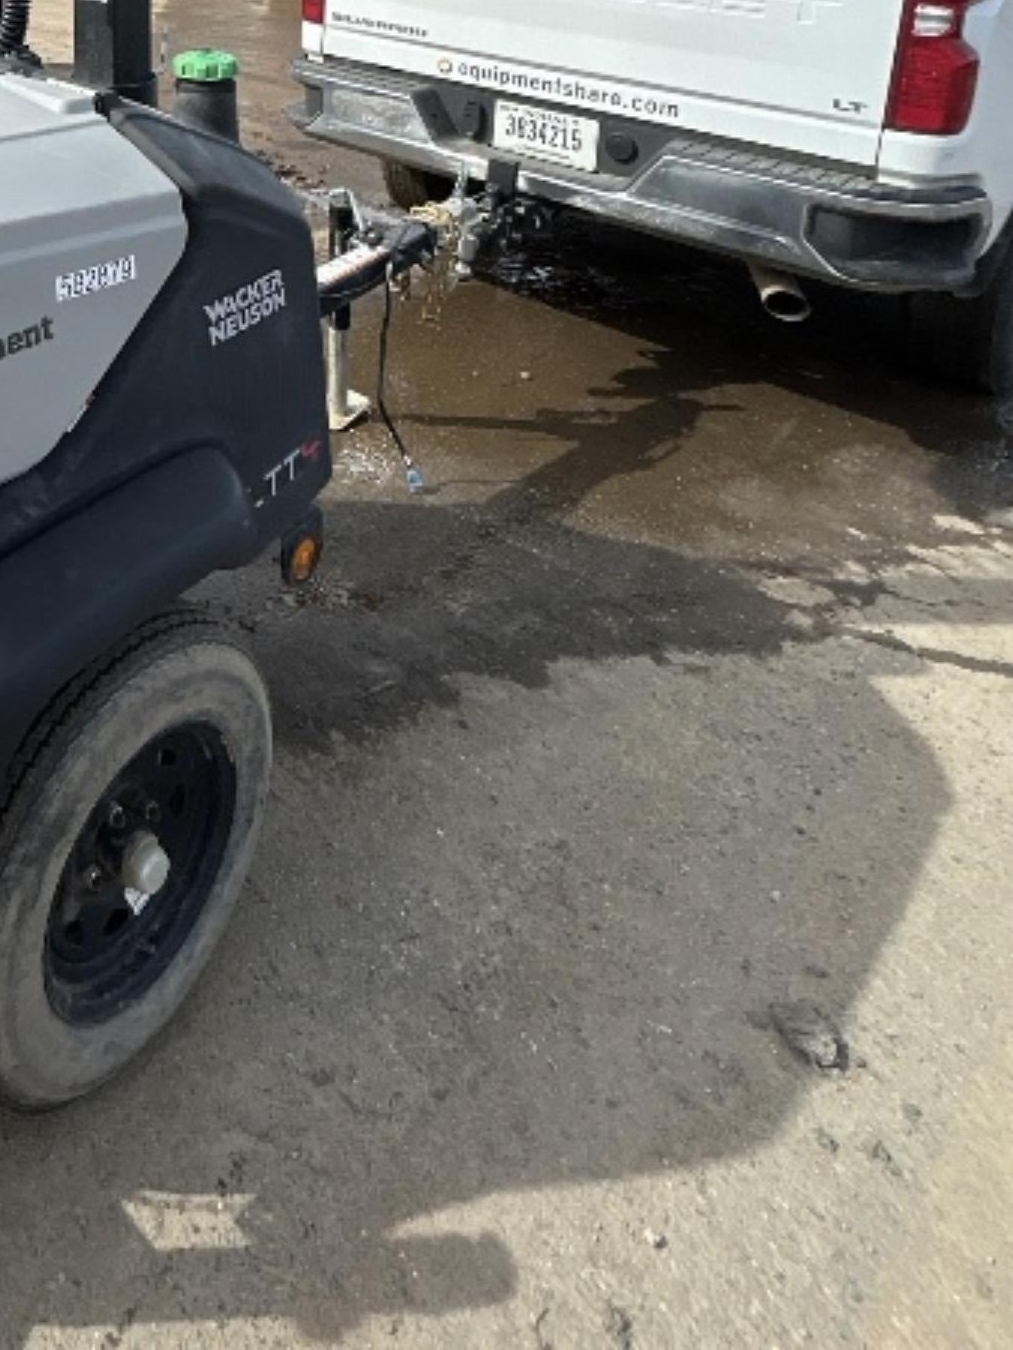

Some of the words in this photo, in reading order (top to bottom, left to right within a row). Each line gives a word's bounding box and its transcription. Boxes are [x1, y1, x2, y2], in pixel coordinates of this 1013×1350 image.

[458, 61, 679, 118] equipmentshare.com
[202, 268, 284, 325] WACKER
[208, 287, 286, 347] NEUSON
